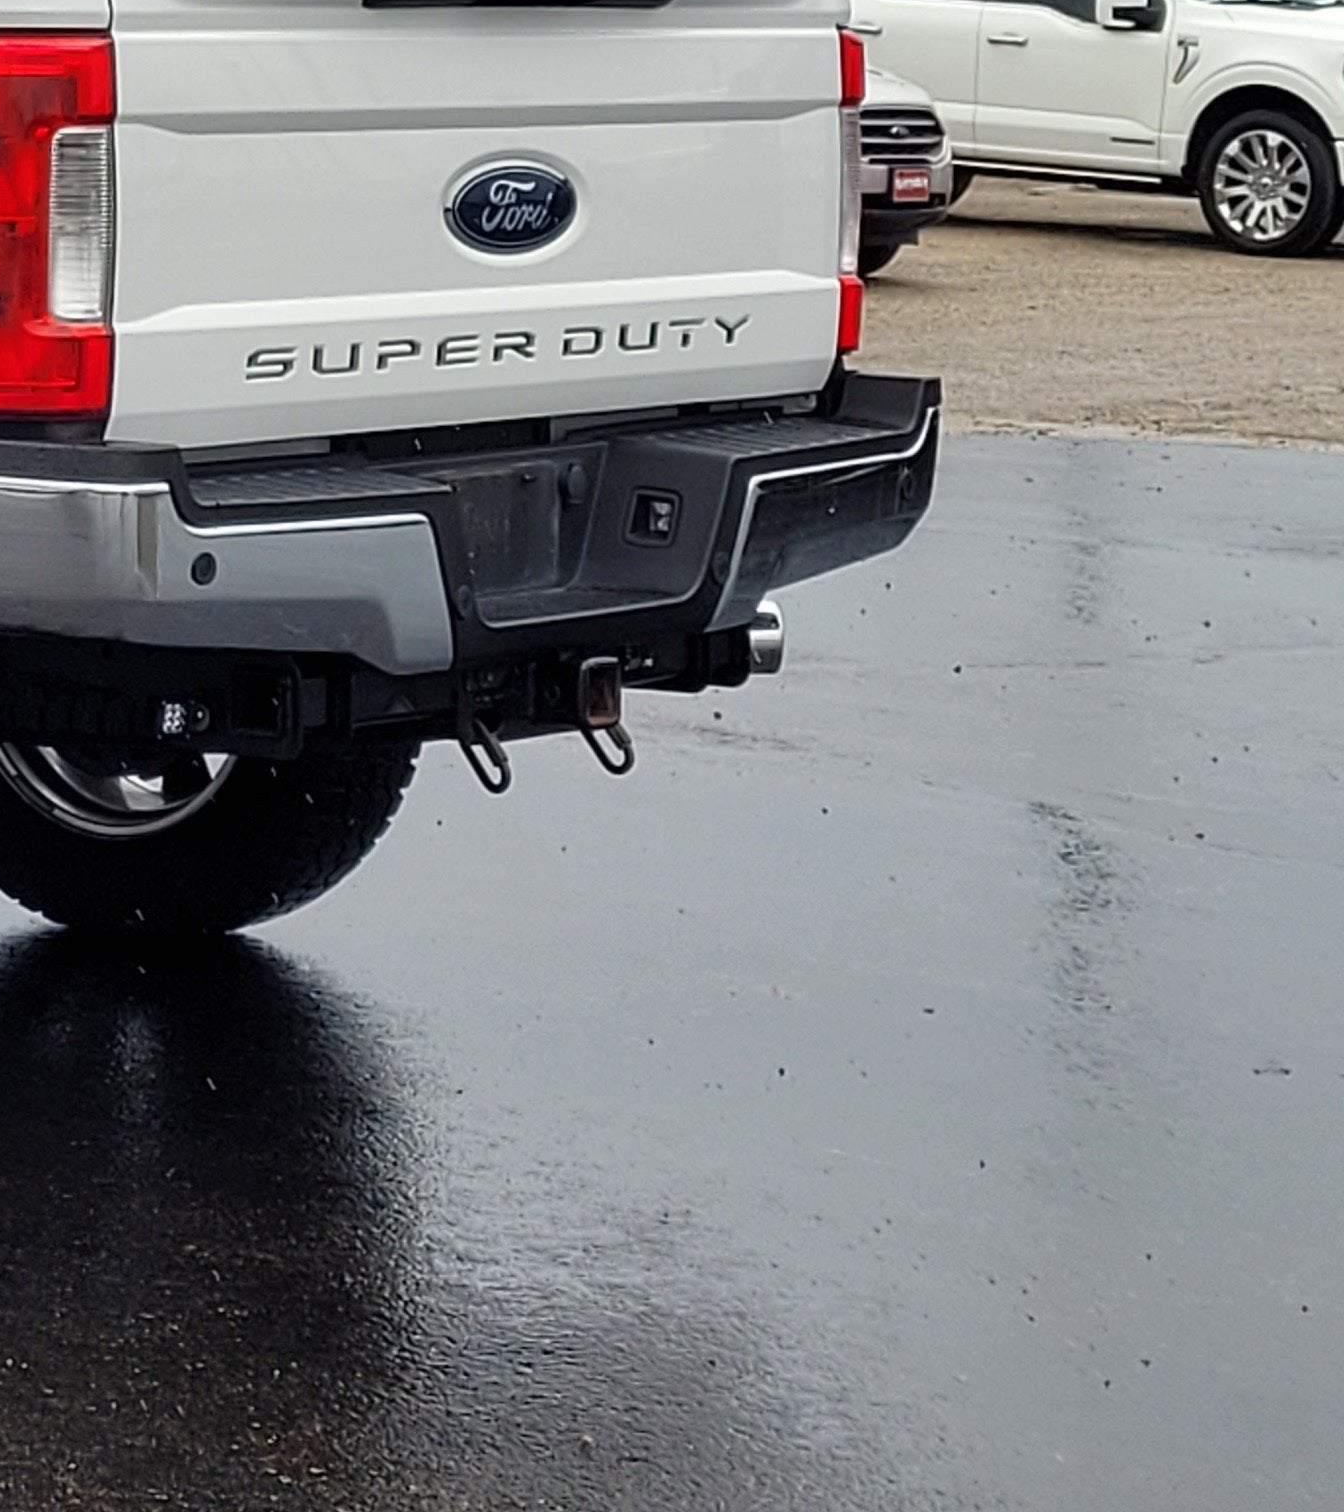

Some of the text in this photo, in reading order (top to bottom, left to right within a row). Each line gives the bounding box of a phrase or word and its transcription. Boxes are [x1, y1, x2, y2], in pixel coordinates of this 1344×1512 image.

[481, 179, 553, 232] Ford
[245, 314, 751, 381] SUPER DUTY
